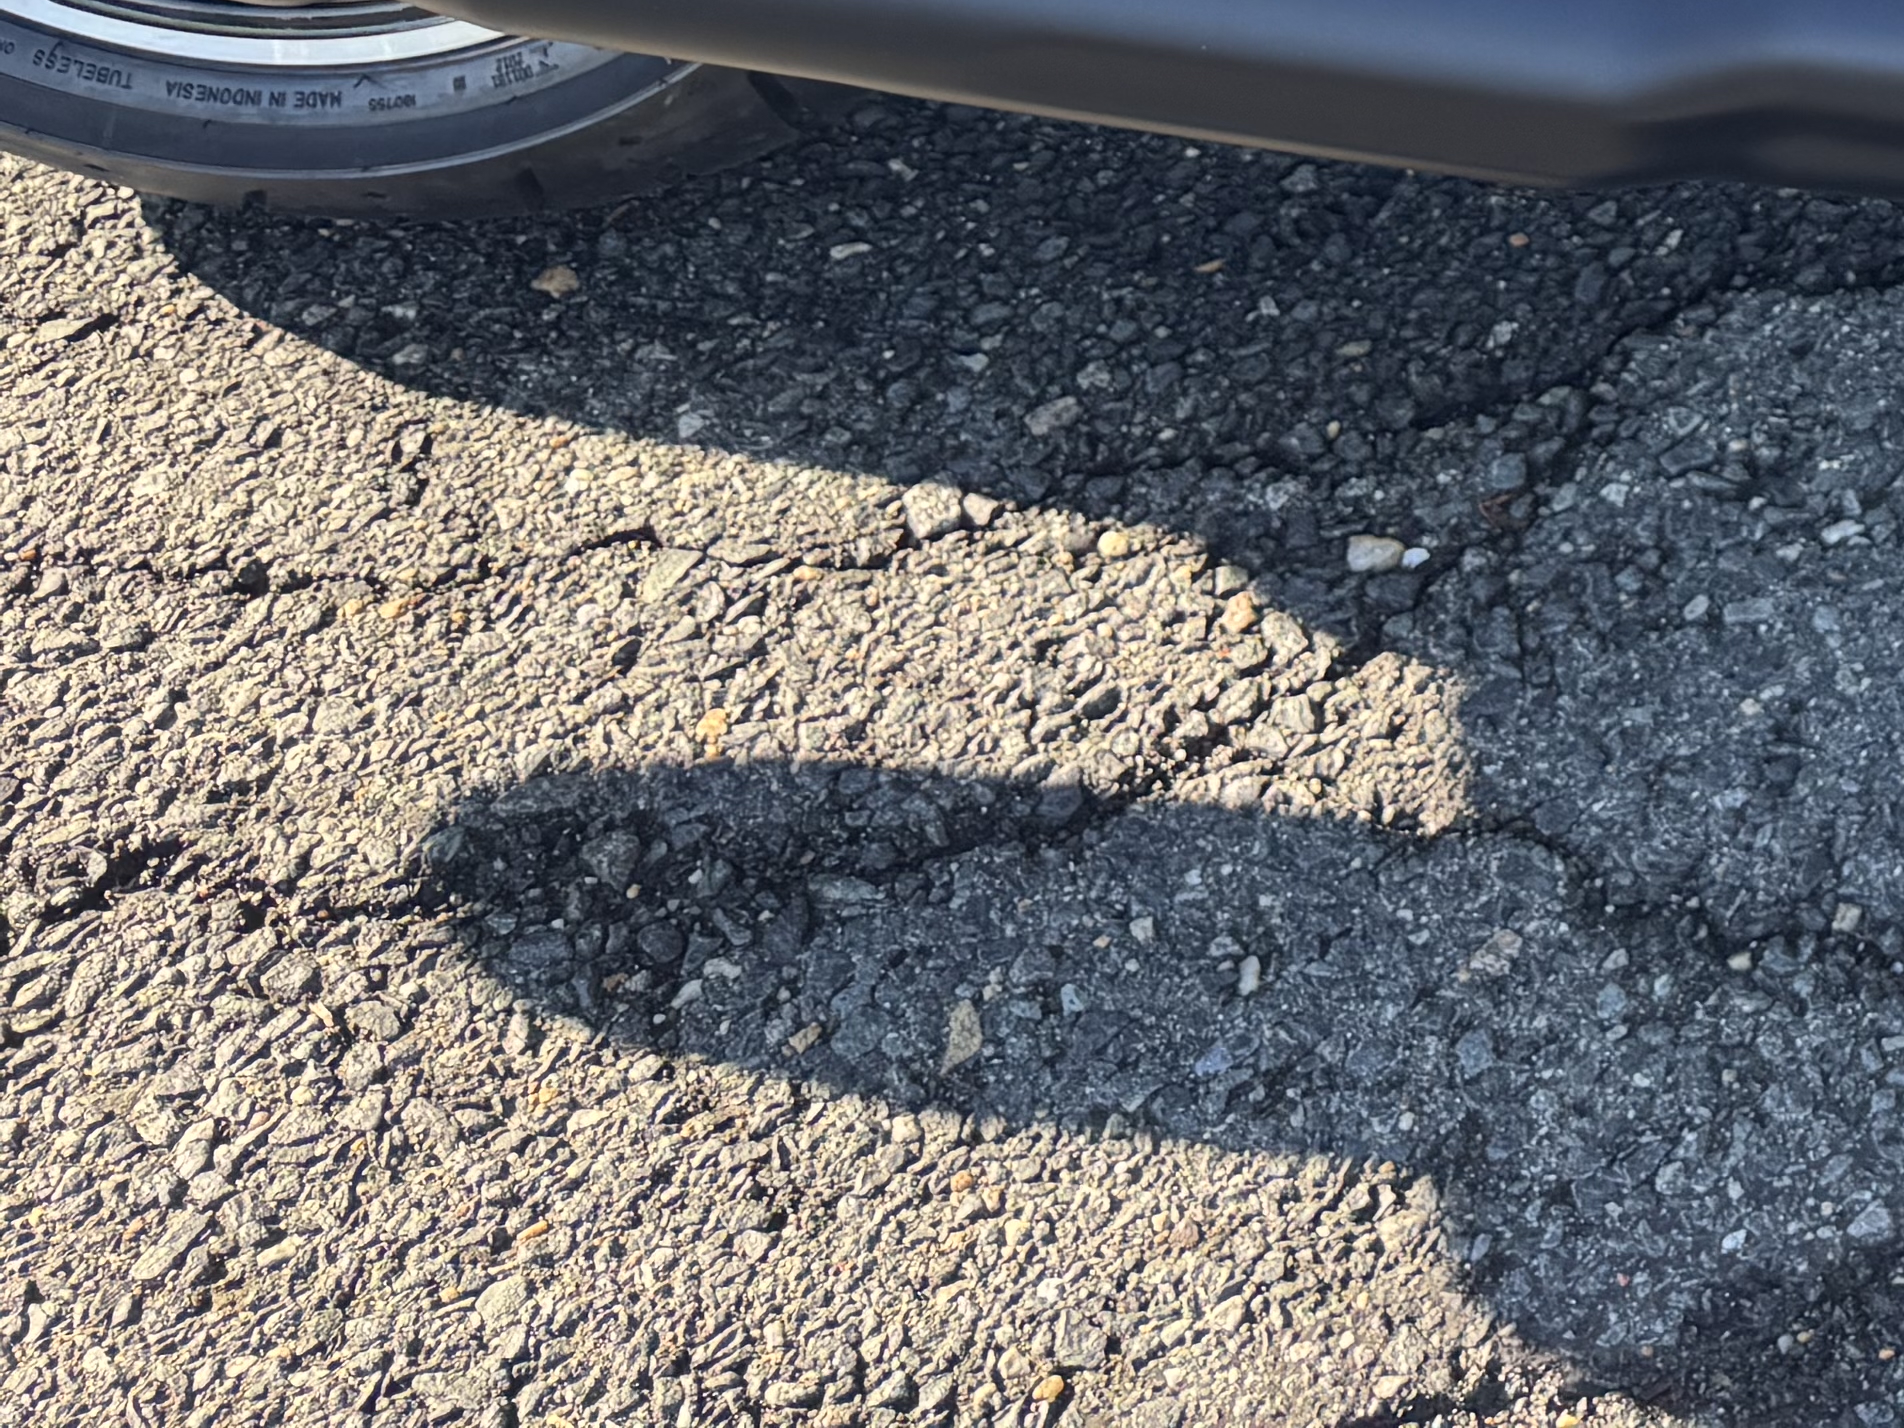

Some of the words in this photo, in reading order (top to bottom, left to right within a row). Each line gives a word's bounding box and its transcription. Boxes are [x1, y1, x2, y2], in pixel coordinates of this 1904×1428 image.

[31, 48, 134, 90] TUBELESS
[165, 79, 262, 107] INDONESIA
[268, 89, 290, 108] IN
[294, 90, 343, 109] MADE
